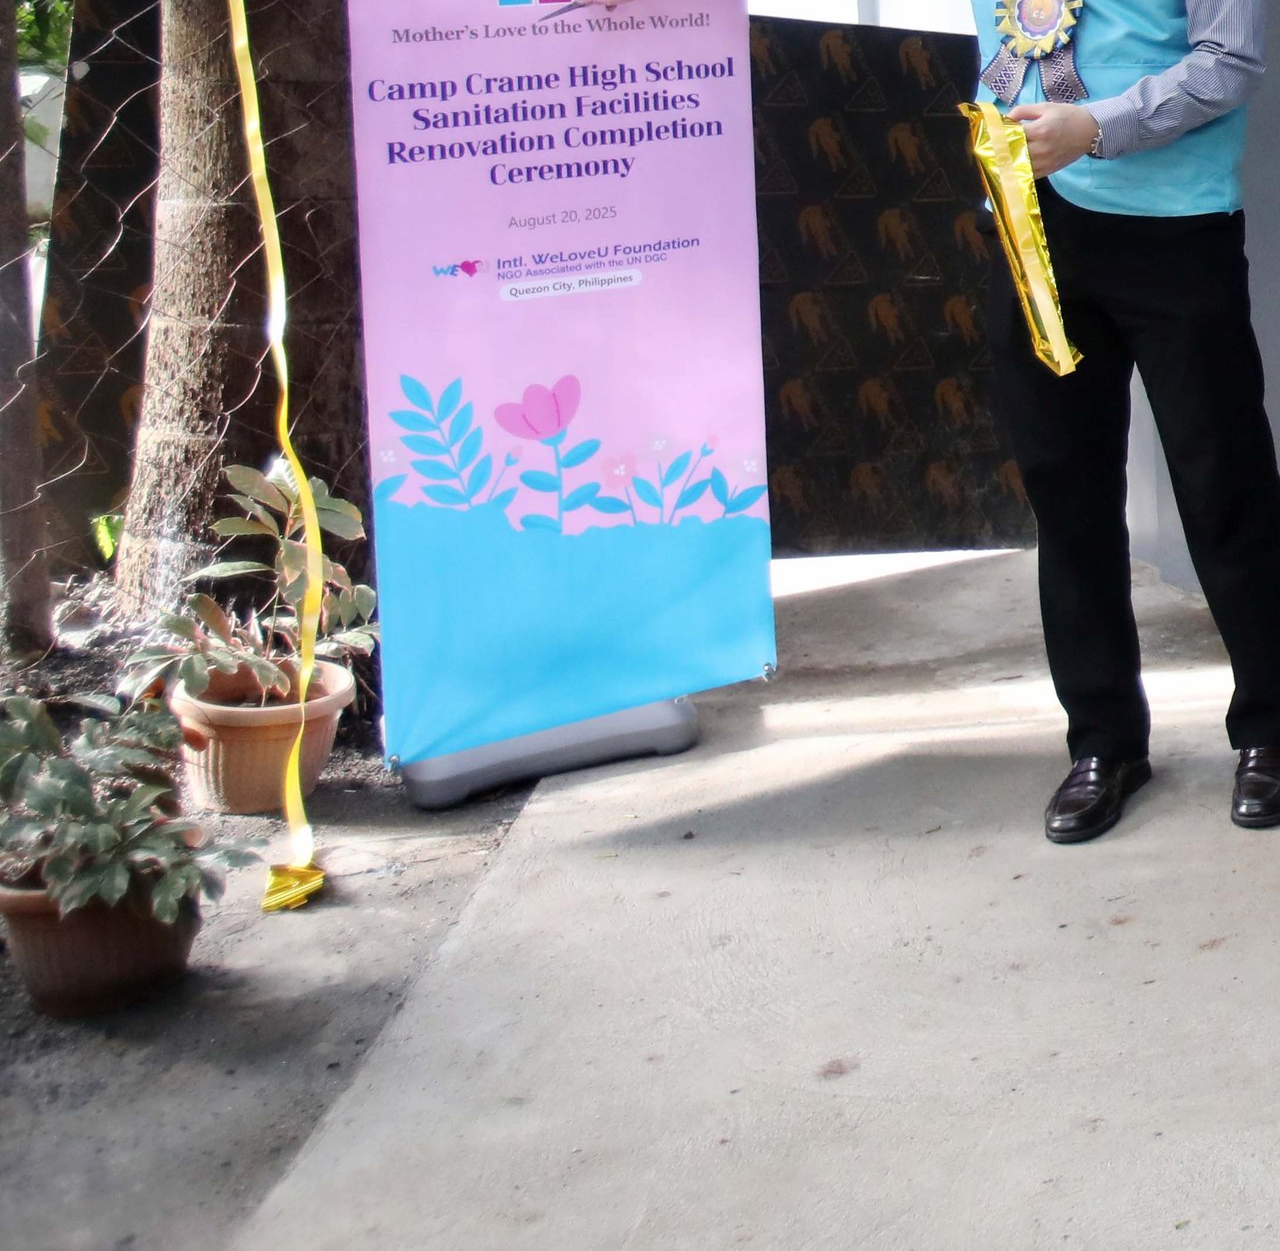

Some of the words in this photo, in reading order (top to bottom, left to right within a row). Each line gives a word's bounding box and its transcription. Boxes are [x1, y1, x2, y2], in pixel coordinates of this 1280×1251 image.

[392, 25, 479, 44] Mother's
[484, 24, 527, 39] Love
[531, 23, 549, 36] to
[553, 19, 582, 34] the
[586, 16, 645, 33] Whole
[650, 12, 711, 29] World!
[368, 79, 457, 102] Camp
[466, 72, 560, 96] Crame
[569, 63, 637, 91] High
[645, 57, 735, 83] School
[412, 99, 567, 131] Sanitation
[575, 89, 700, 118] Facilities
[387, 131, 556, 165] Renovation
[564, 117, 724, 148] Completion
[490, 157, 635, 186] Ceremony
[508, 213, 557, 229] August
[561, 210, 580, 224] 20,
[585, 206, 617, 221] 2025
[496, 256, 527, 270] Intl.
[531, 246, 609, 266] WeLoveU
[613, 236, 701, 256] Foundation
[497, 269, 523, 280] NGO
[525, 262, 582, 277] Associated
[584, 260, 606, 270] with
[608, 258, 624, 268] the
[626, 255, 642, 265] UN
[644, 252, 668, 264] DGC
[508, 285, 550, 298] Quezon
[552, 281, 575, 292] City,
[577, 274, 634, 288] Philippines
